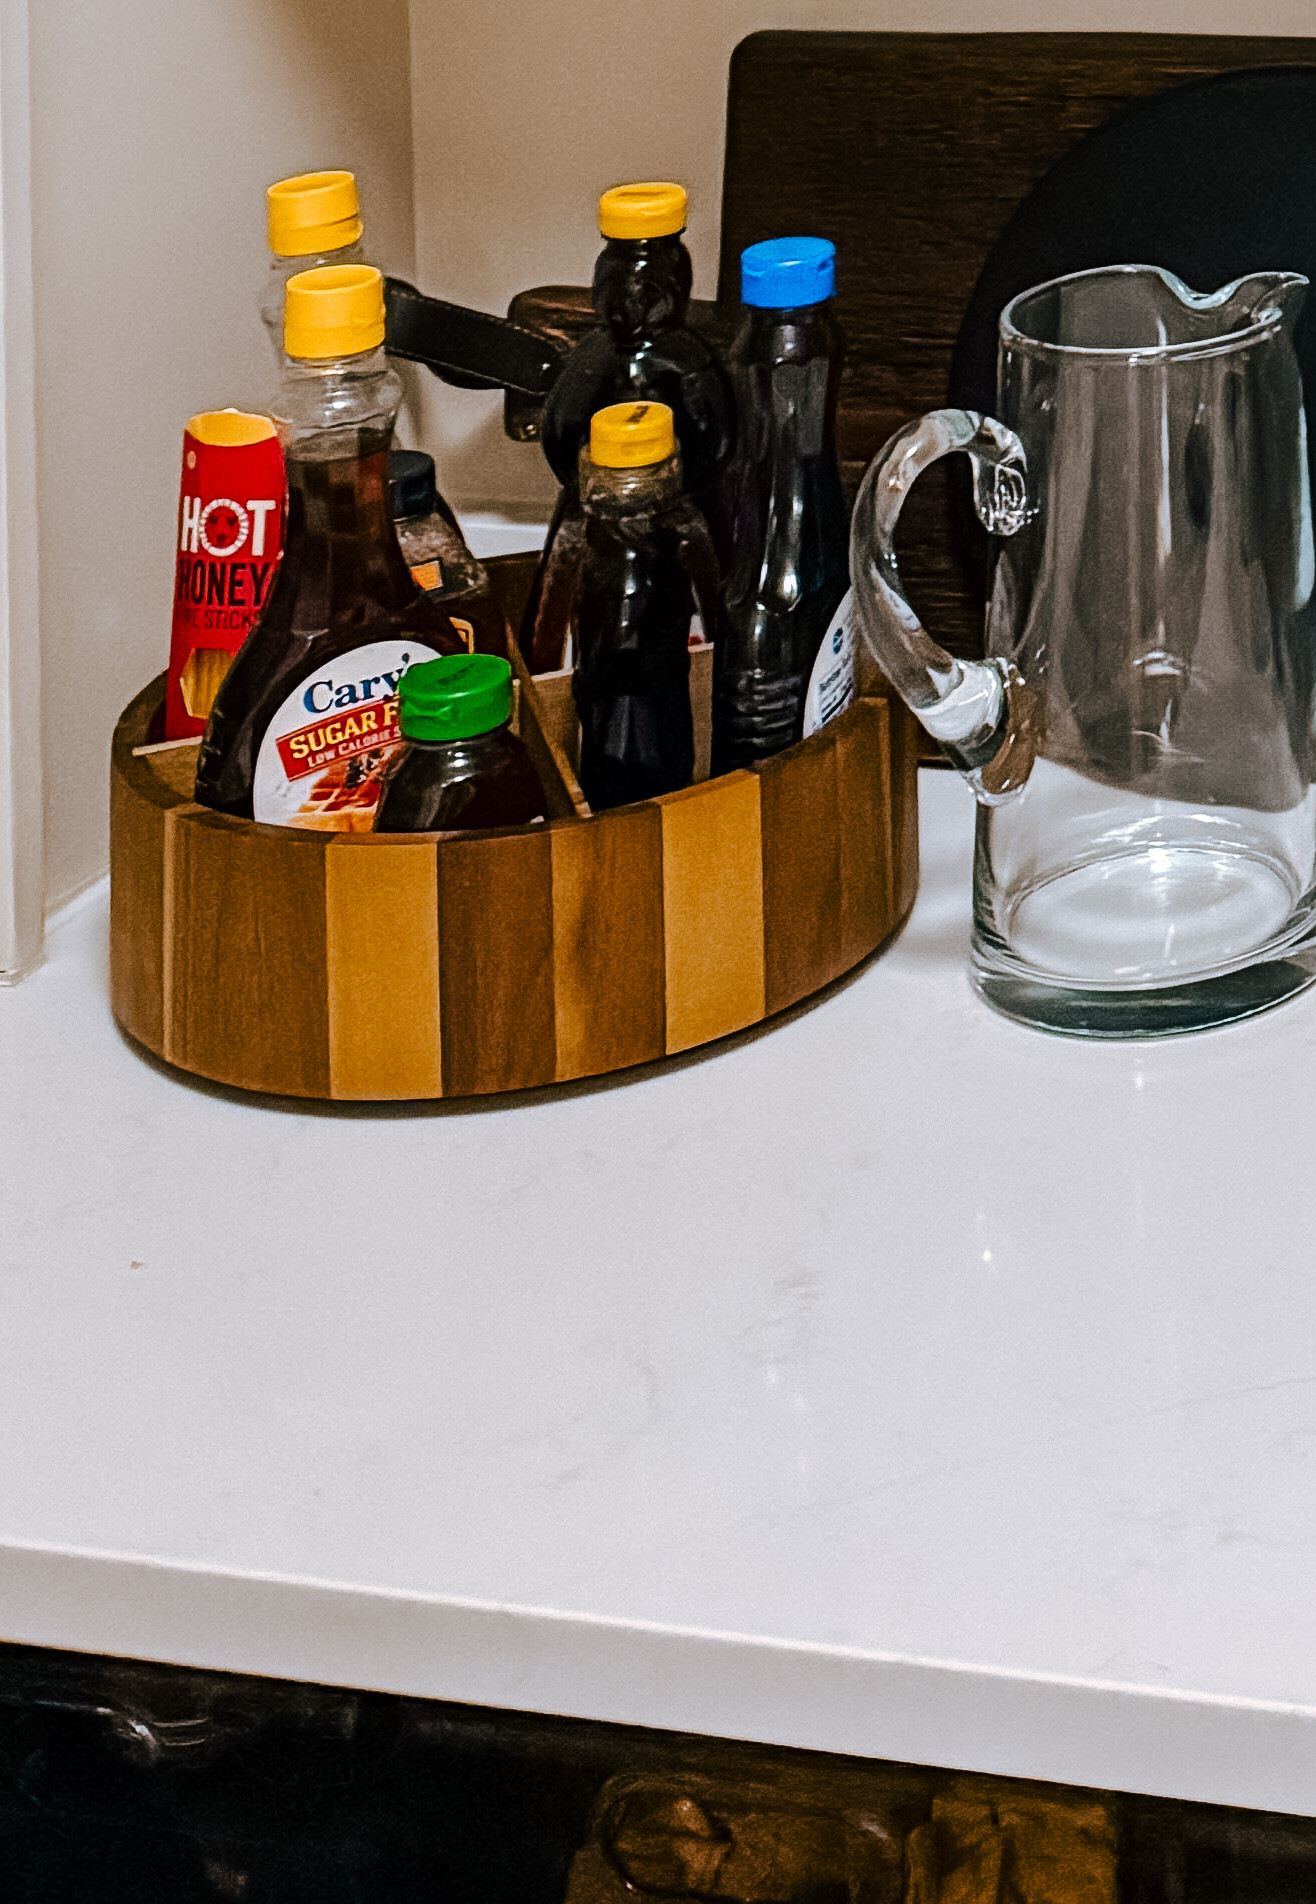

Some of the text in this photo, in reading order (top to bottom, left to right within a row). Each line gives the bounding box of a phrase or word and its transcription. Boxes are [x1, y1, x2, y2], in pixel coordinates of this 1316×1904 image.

[181, 495, 277, 557] HOT
[177, 557, 271, 607] HONEY
[288, 709, 378, 760] SUGAR
